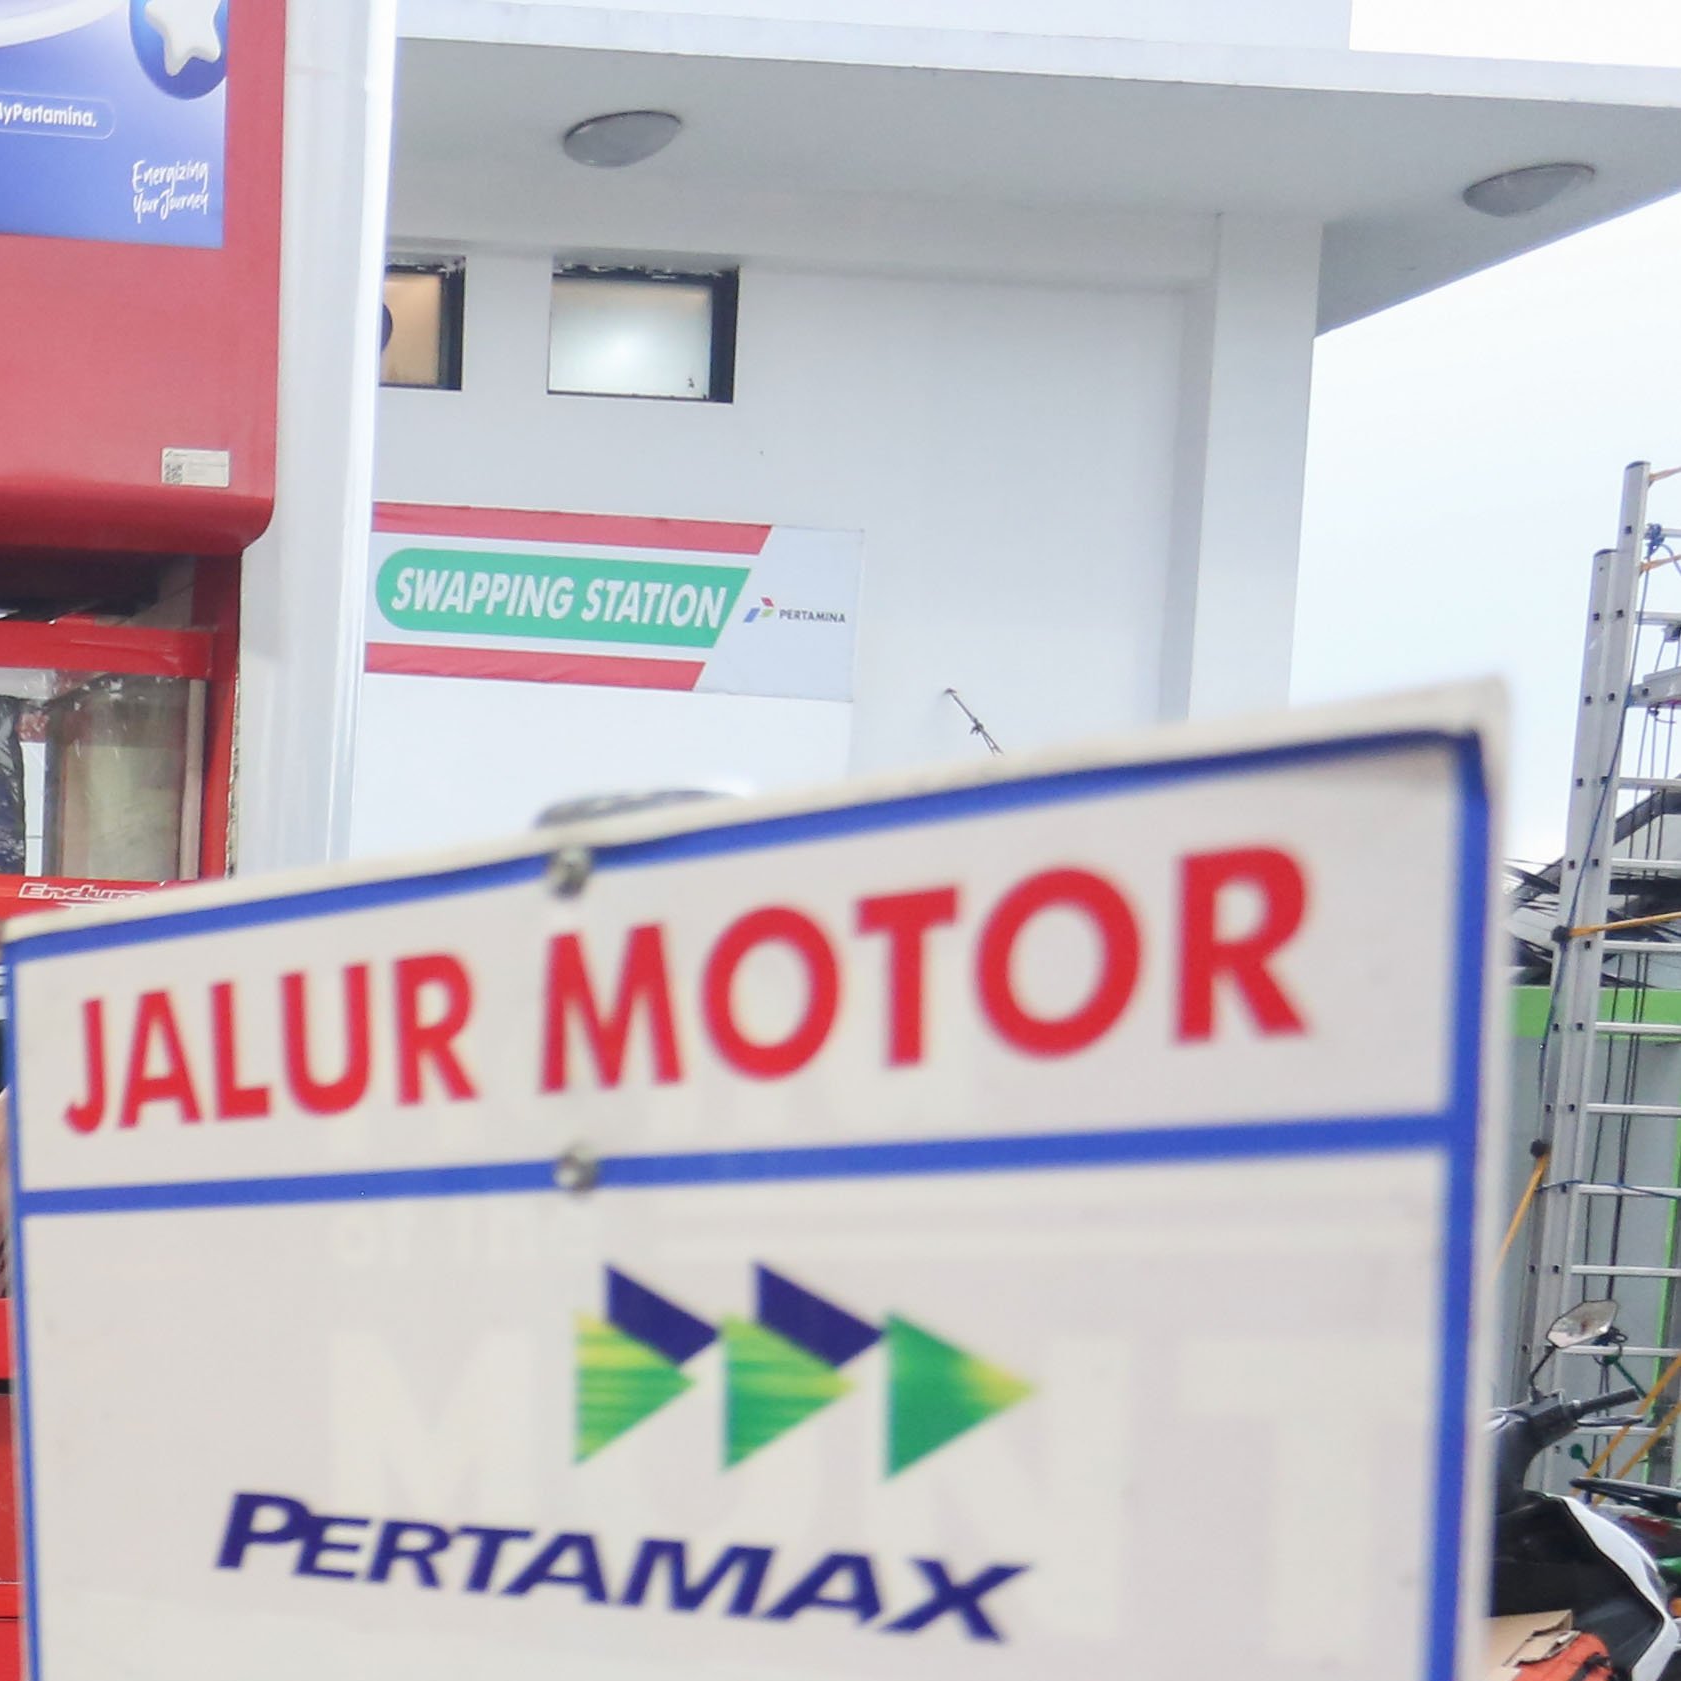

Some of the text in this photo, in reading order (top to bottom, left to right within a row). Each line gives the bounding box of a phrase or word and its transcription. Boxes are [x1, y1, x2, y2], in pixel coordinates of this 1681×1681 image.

[132, 159, 210, 190] Energizing
[160, 191, 210, 220] Journey
[392, 567, 729, 629] SWAPPING STATION
[779, 609, 845, 623] PERTAMINA
[64, 847, 1308, 1135] JALUR MOTOR
[214, 1492, 1030, 1645] PERTAMAX
